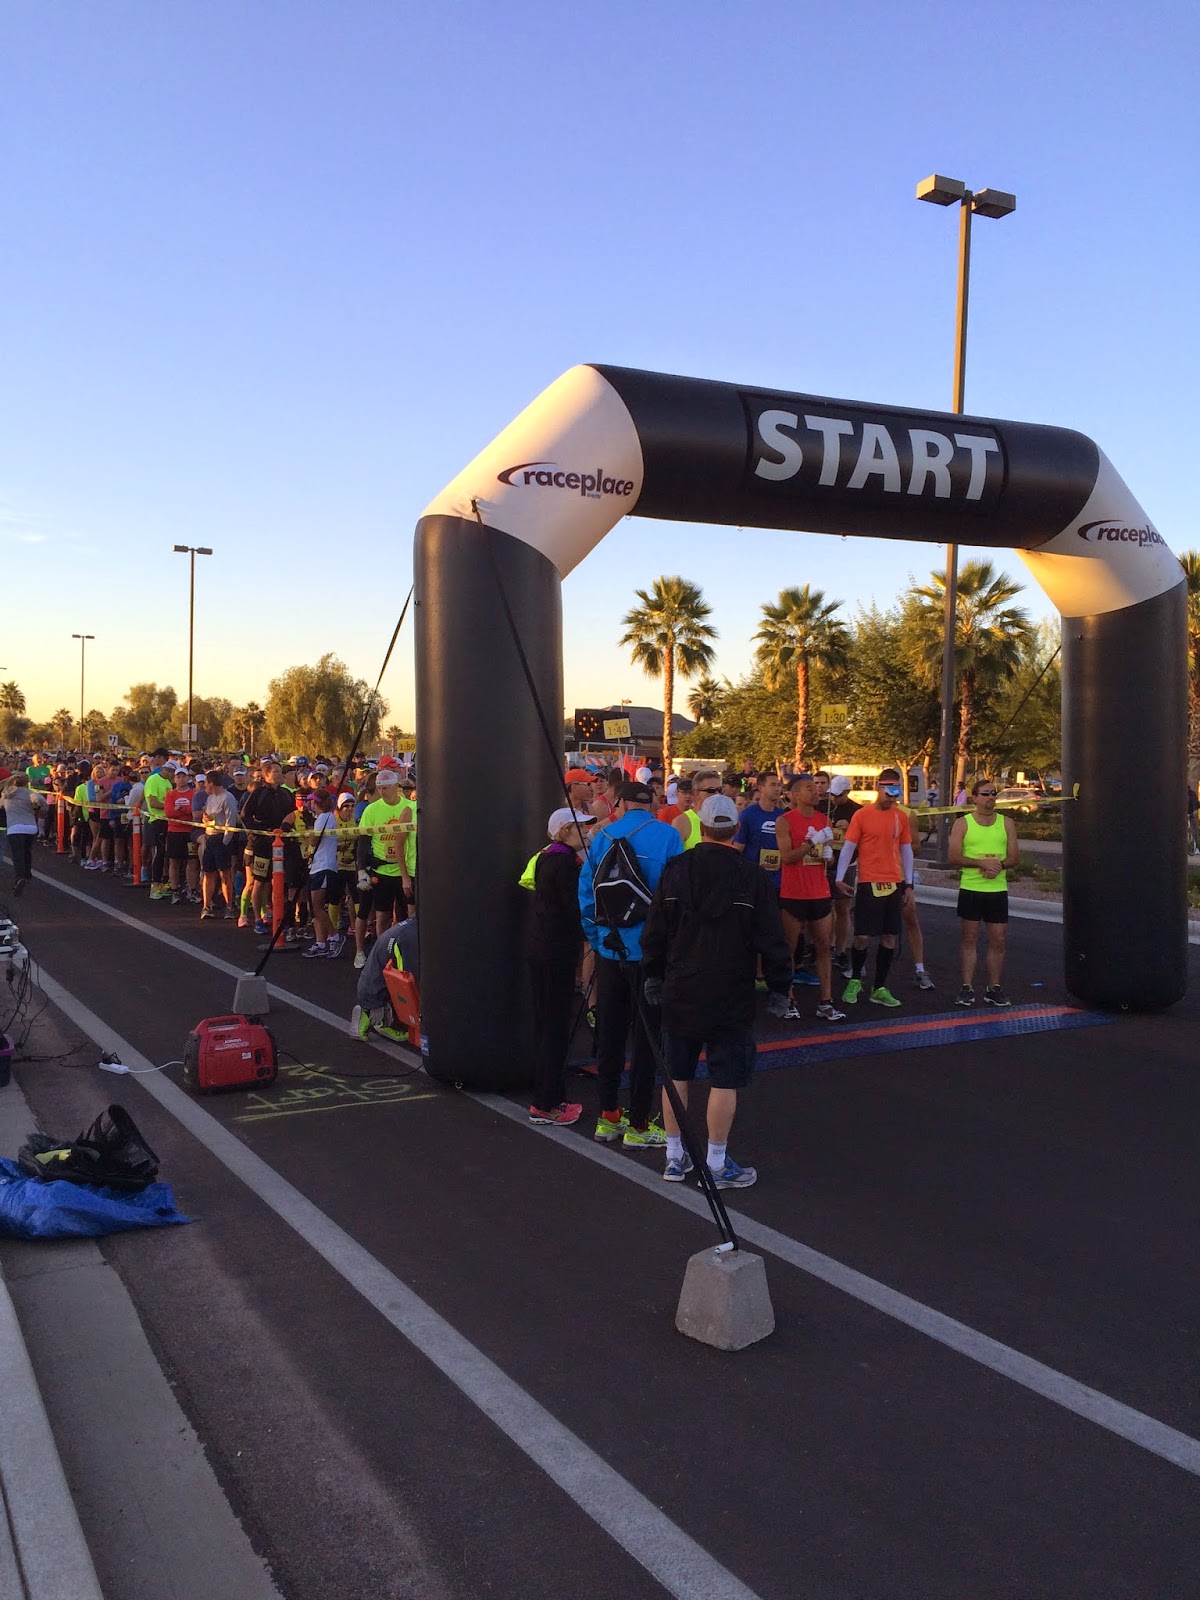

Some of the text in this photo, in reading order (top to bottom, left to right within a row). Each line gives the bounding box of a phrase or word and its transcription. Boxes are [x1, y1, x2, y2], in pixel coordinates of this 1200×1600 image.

[754, 409, 999, 501] START
[523, 468, 635, 497] raceplace
[823, 712, 845, 724] 1:30
[607, 725, 629, 735] 1:40
[399, 743, 415, 751] 1:50
